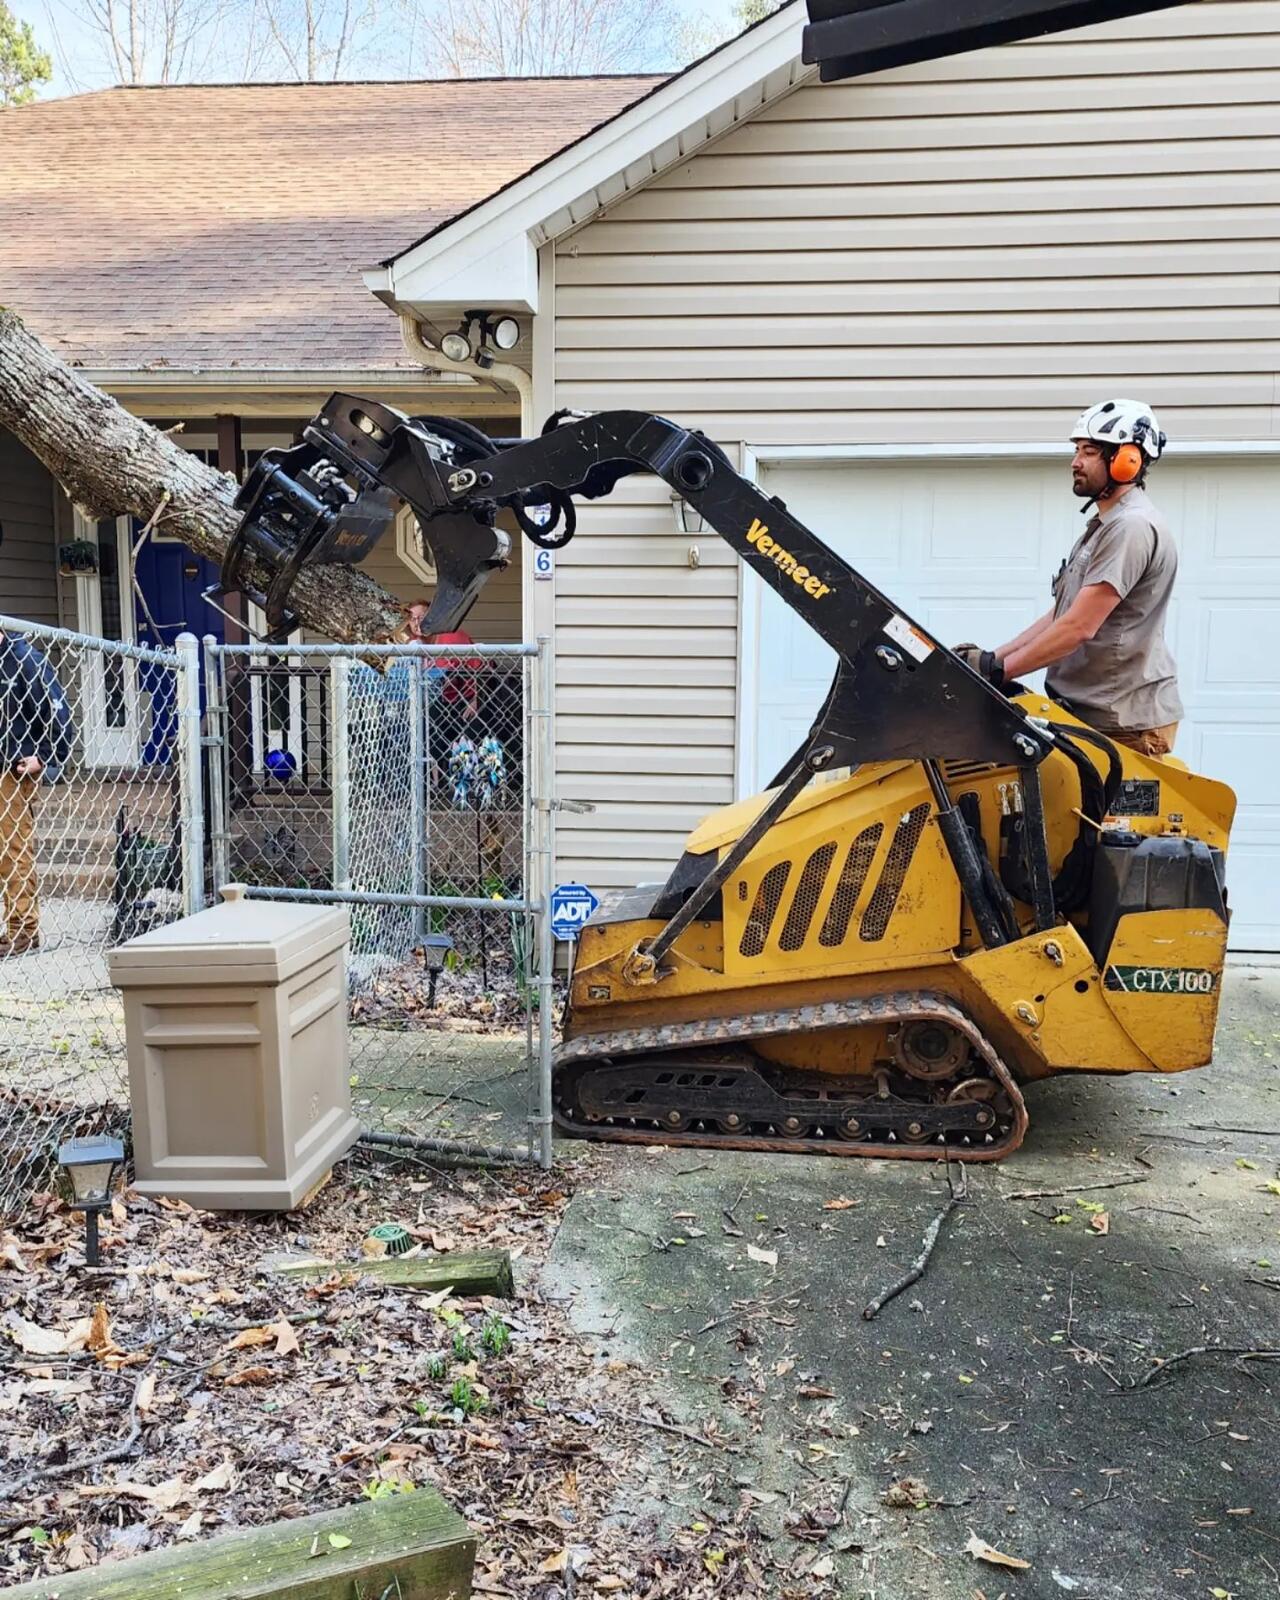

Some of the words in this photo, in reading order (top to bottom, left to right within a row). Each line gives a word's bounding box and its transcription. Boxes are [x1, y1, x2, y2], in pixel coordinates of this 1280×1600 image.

[537, 551, 550, 571] 6
[745, 517, 830, 601] Vermeer
[553, 902, 591, 922] ADT
[1133, 969, 1212, 992] CTX100
